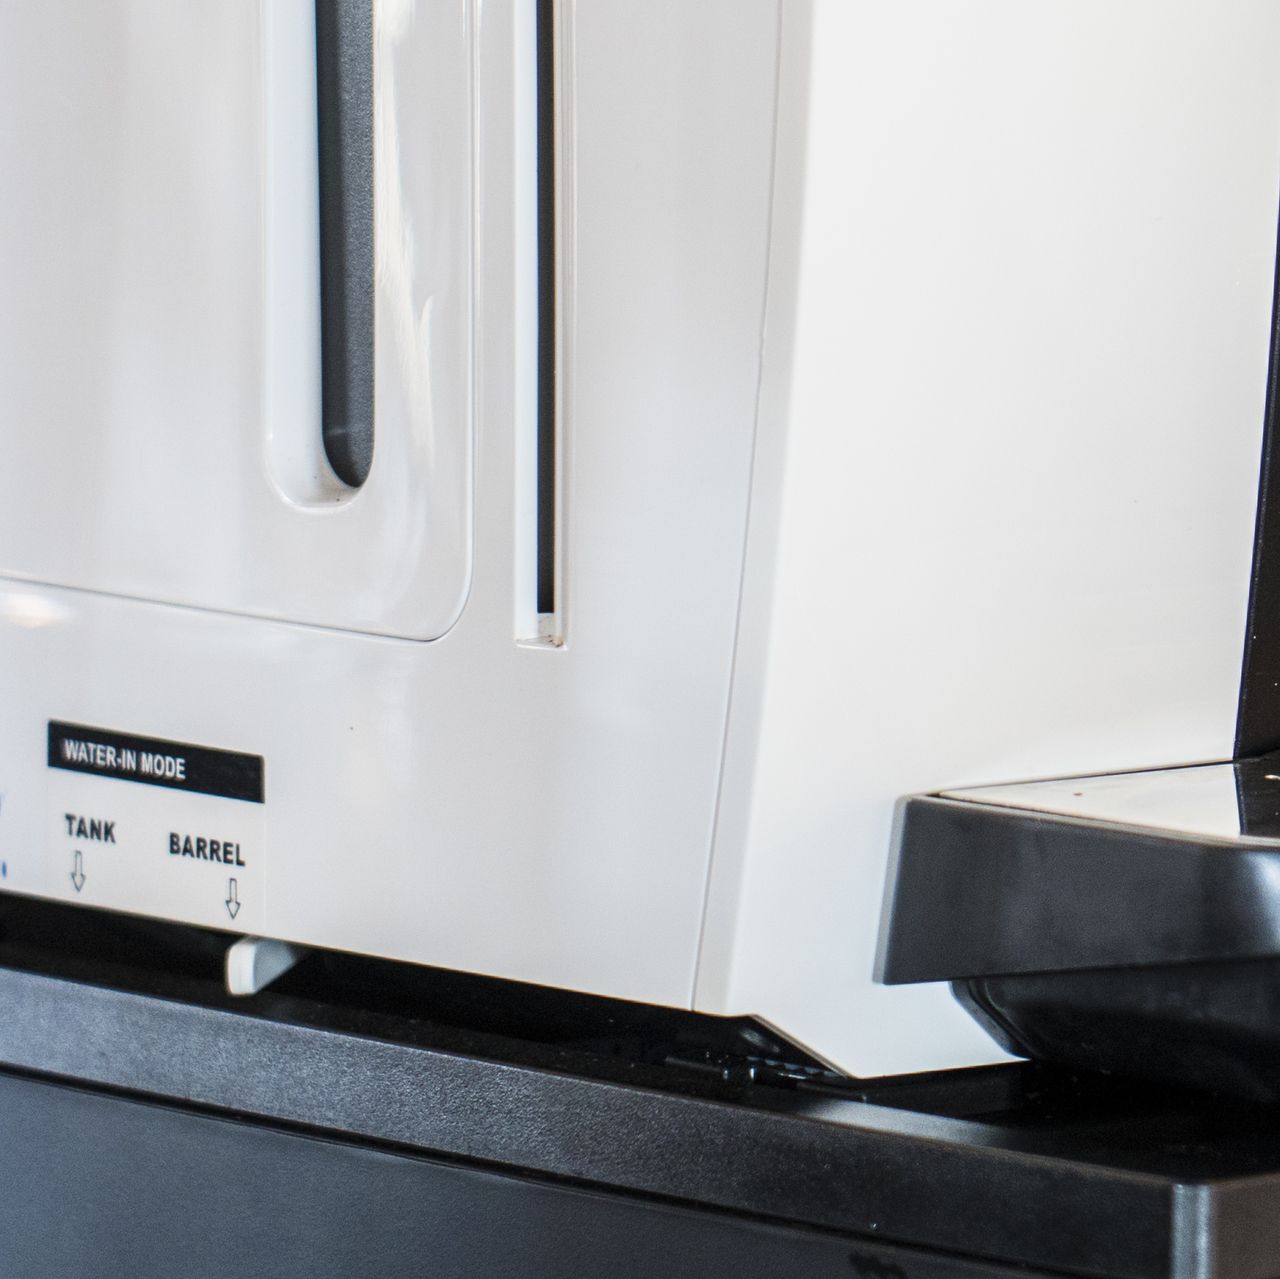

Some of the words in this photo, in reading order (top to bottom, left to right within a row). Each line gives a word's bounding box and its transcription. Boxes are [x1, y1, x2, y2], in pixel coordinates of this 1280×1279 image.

[62, 738, 137, 771] WATER-IN
[140, 751, 187, 781] MODE
[64, 812, 117, 844] TANK
[169, 831, 246, 867] BARREL
